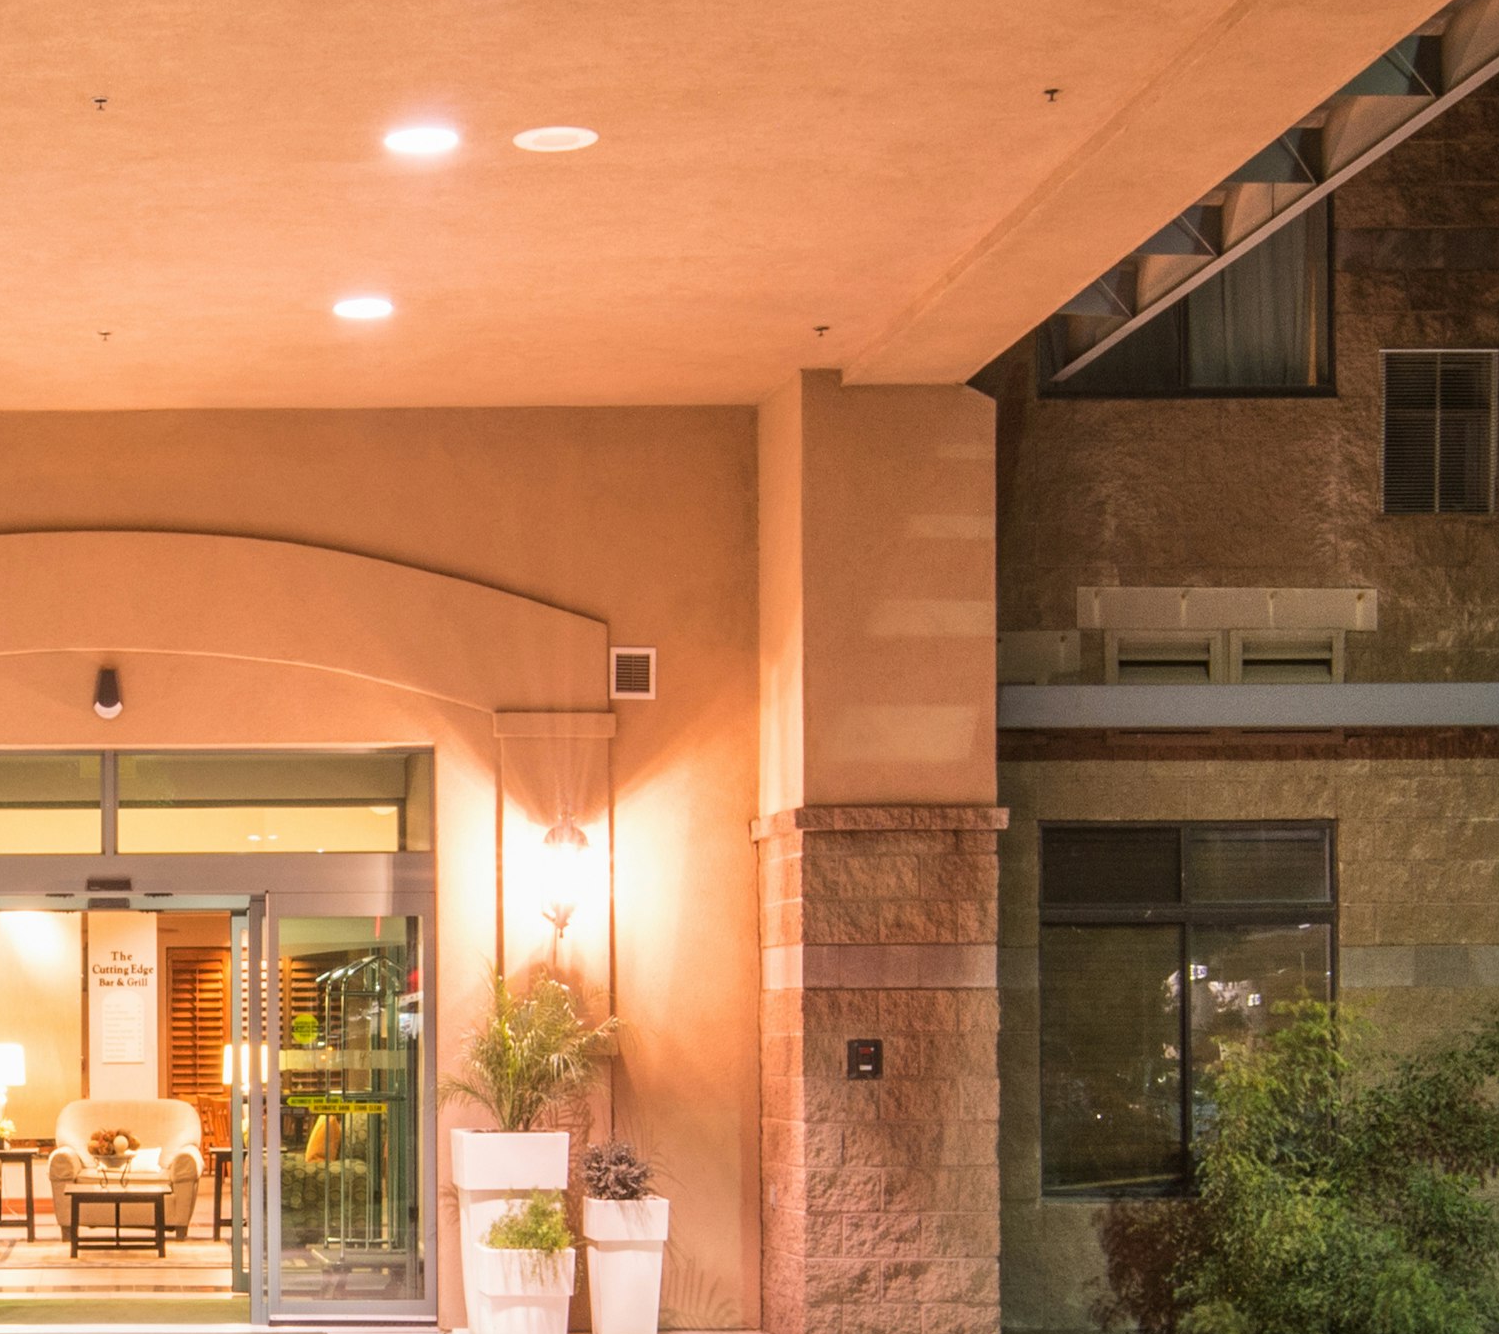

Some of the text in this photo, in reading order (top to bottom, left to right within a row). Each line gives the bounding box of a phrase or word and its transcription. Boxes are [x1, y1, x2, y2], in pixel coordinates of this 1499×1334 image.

[111, 951, 133, 961] The
[92, 964, 154, 976] Cutting Edge
[99, 978, 148, 986] Bar & Grill
